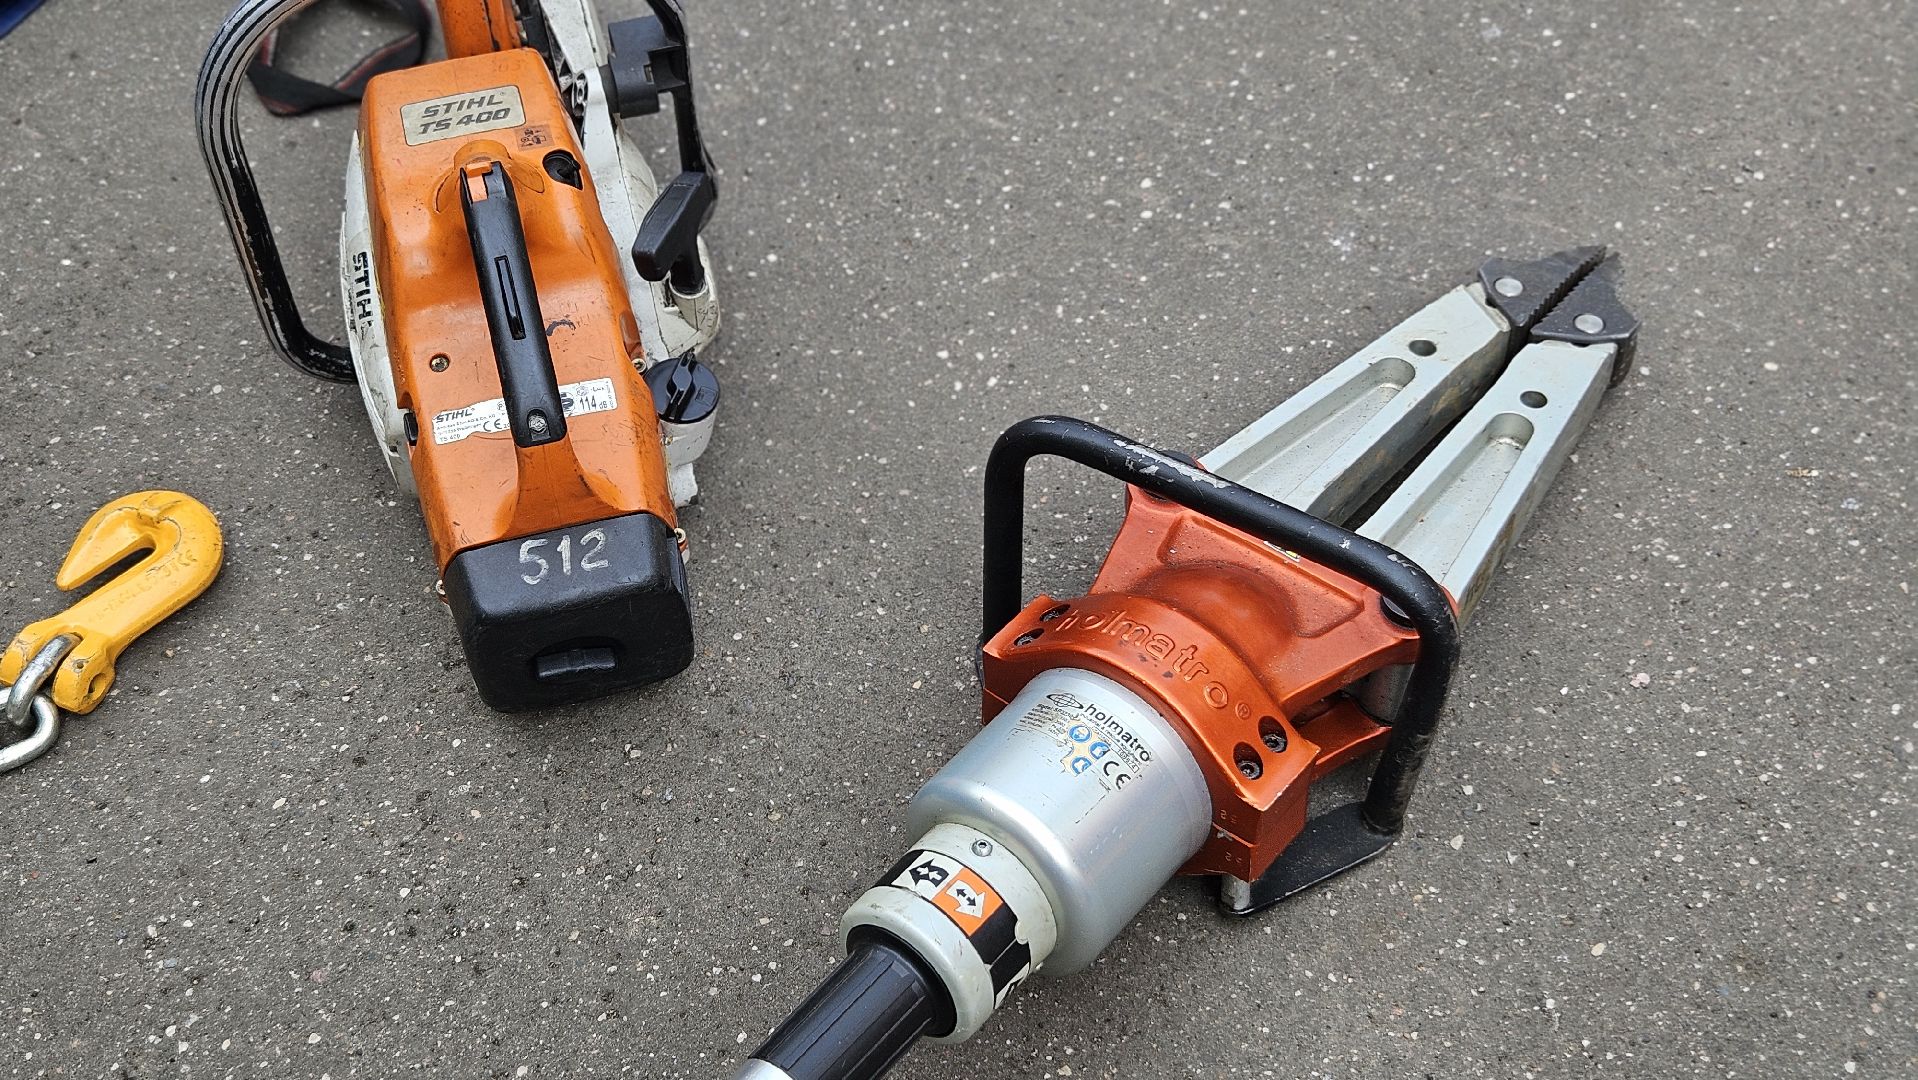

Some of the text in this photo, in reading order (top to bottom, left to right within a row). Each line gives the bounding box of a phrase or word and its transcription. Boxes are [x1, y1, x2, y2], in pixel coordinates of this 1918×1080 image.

[421, 94, 504, 119] STIHL
[418, 107, 511, 135] TS 400
[435, 409, 473, 424] STIHL
[580, 395, 597, 411] 114
[519, 527, 611, 585] 512
[1055, 608, 1229, 710] holmatro
[1084, 703, 1150, 762] holmatro
